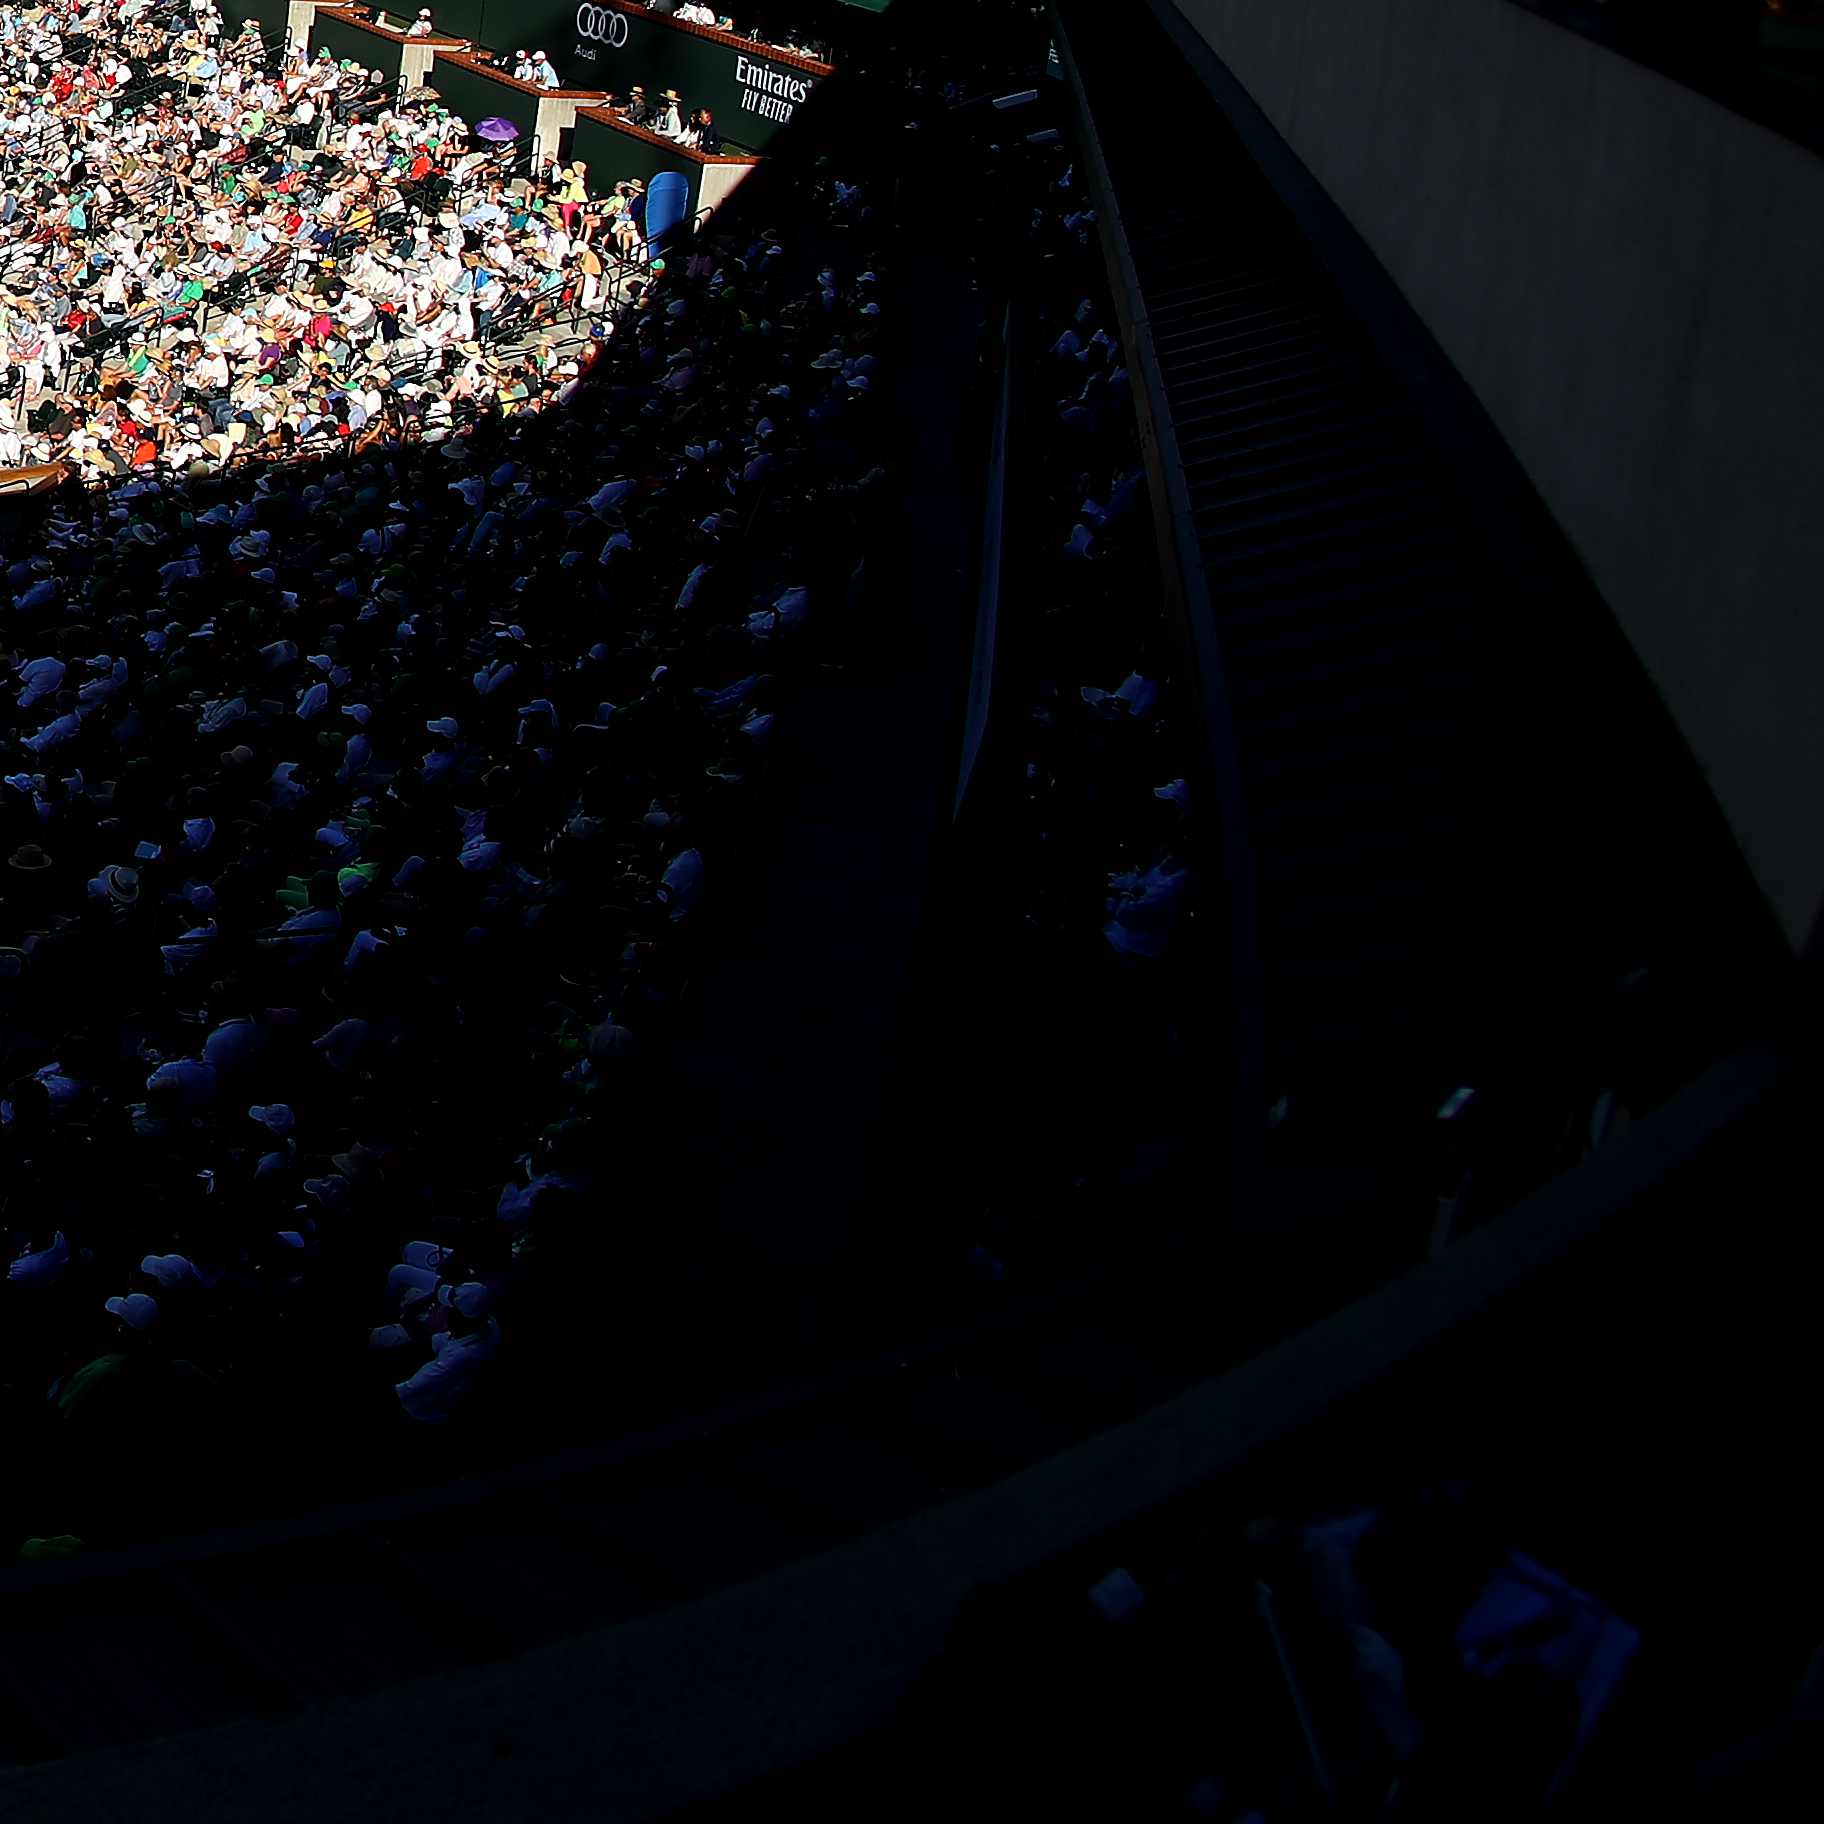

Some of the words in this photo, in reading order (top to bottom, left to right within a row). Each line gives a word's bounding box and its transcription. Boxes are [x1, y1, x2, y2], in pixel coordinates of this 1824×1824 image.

[574, 44, 597, 61] Audi
[735, 55, 808, 104] Emirates
[741, 88, 761, 113] FLY
[758, 95, 795, 125] BETTER
